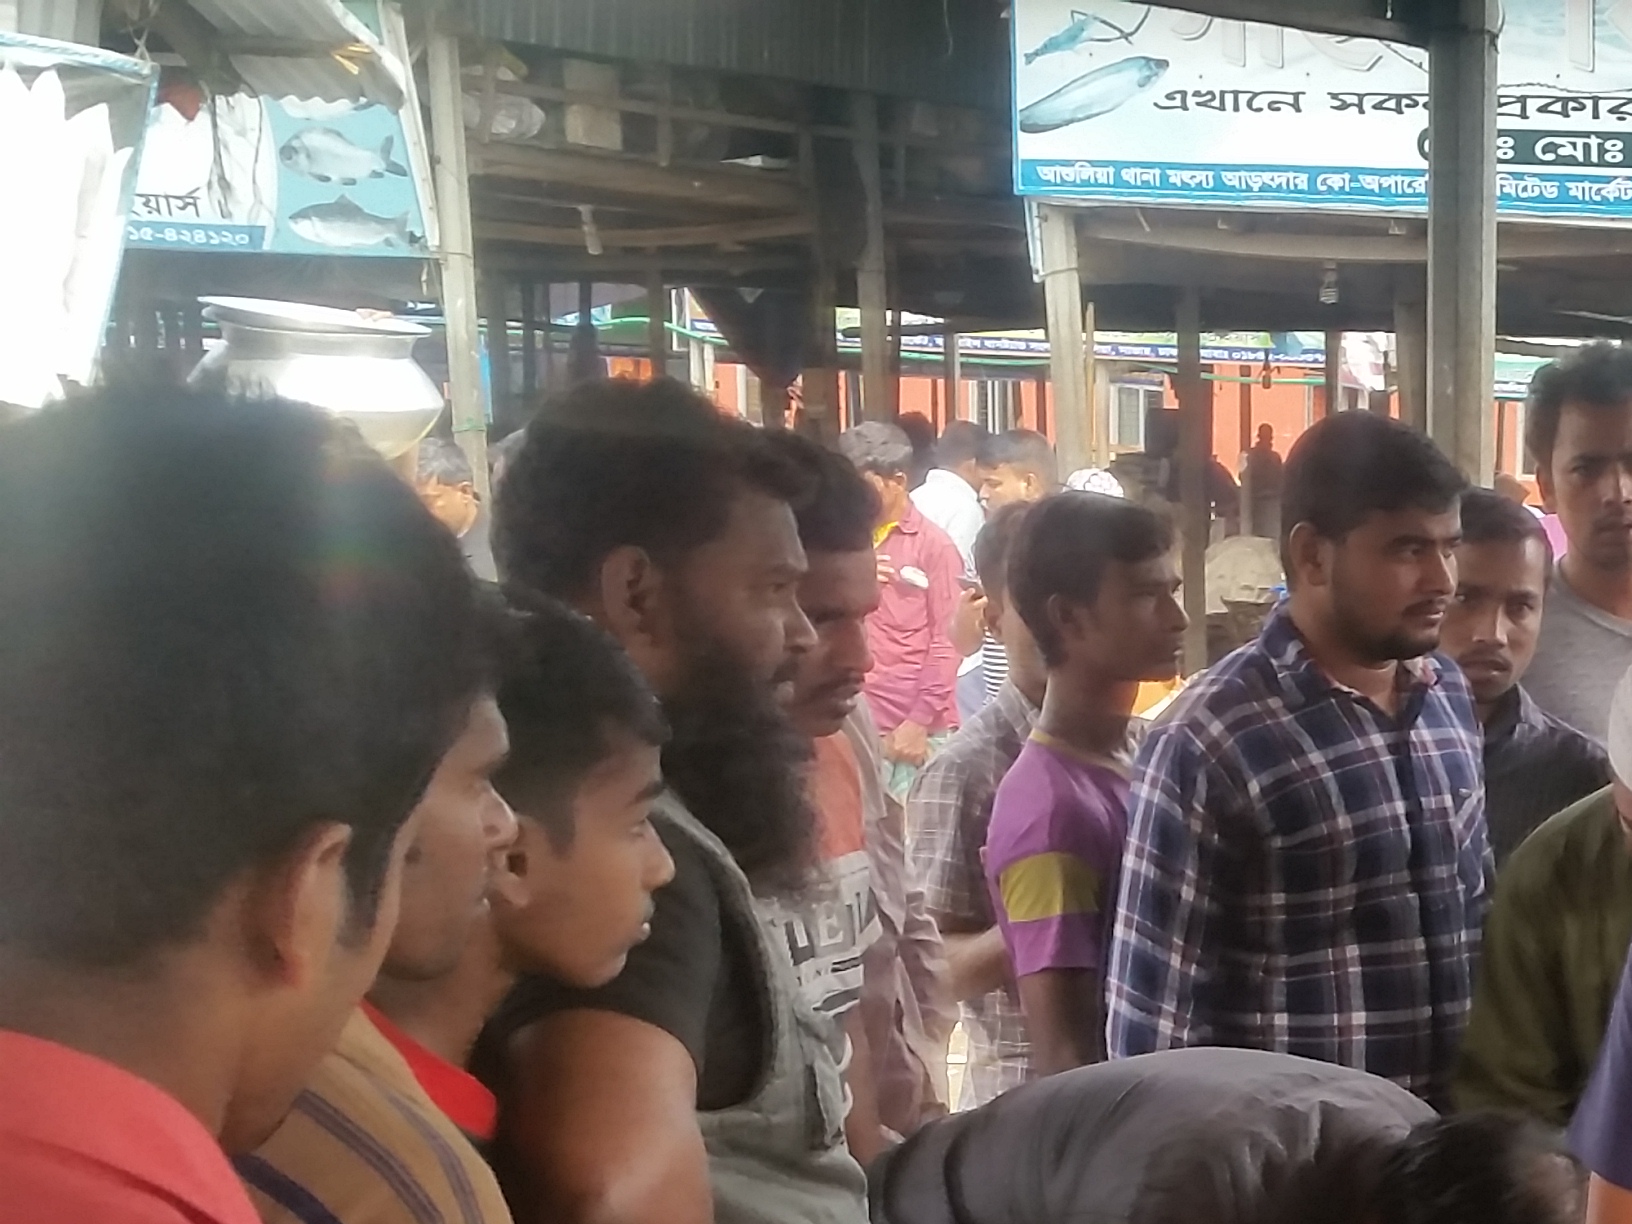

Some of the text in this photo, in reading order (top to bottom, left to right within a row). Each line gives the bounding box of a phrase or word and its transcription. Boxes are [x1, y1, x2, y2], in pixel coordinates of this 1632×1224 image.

[1153, 88, 1307, 114] এখানে
[1326, 91, 1430, 115] সক
[1533, 134, 1625, 164] মোঃ
[1120, 167, 1162, 188] থানা
[1316, 172, 1428, 194] কো-অপারে
[1496, 173, 1560, 199] মিটেড
[133, 186, 201, 218] য়ার্স
